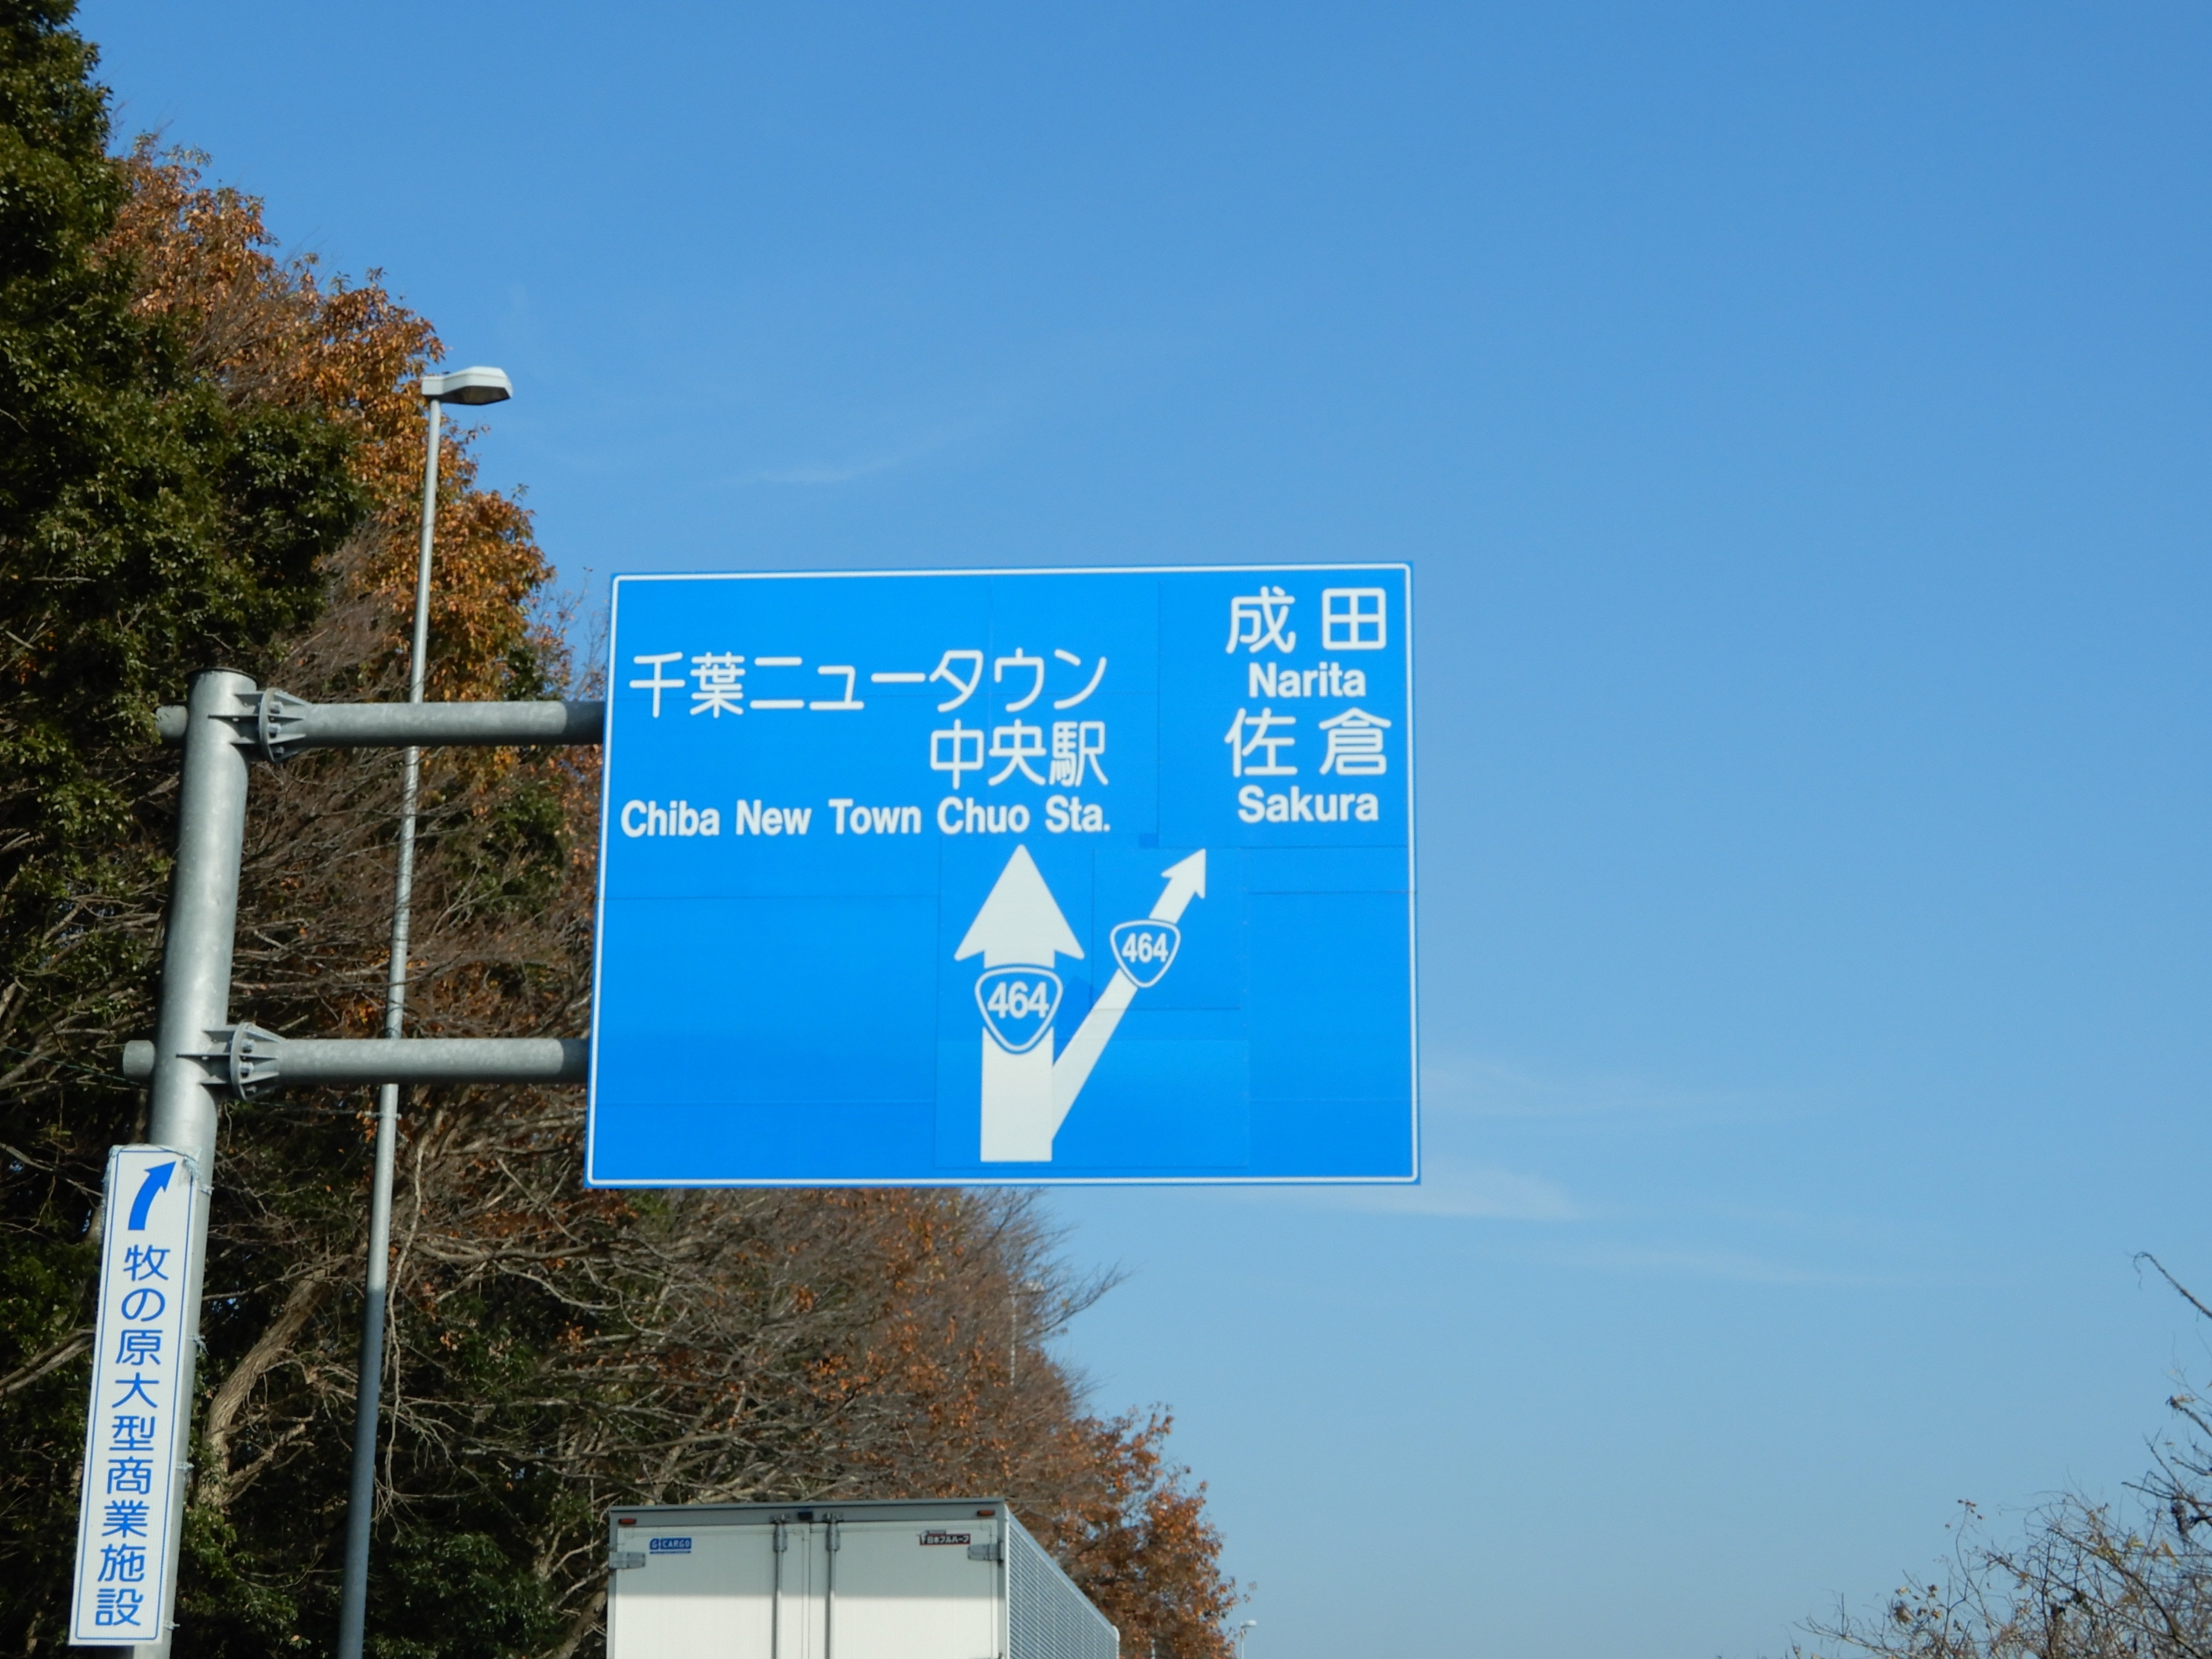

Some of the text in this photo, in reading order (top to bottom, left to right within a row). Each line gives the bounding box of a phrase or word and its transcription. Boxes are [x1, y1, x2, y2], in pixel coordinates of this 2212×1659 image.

[1225, 586, 1386, 654] 成田
[629, 648, 1107, 718] 千葉ニュータウン
[1249, 661, 1366, 698] Narita
[930, 719, 1109, 790] 中央駅
[1224, 707, 1391, 777] 佐倉
[621, 795, 1110, 838] Chiba New Town Chuo Sta.
[1238, 784, 1379, 824] Sakura
[1122, 932, 1169, 963] 464
[987, 981, 1050, 1019] 464
[95, 1244, 171, 1627] 牧の原大型商業施設
